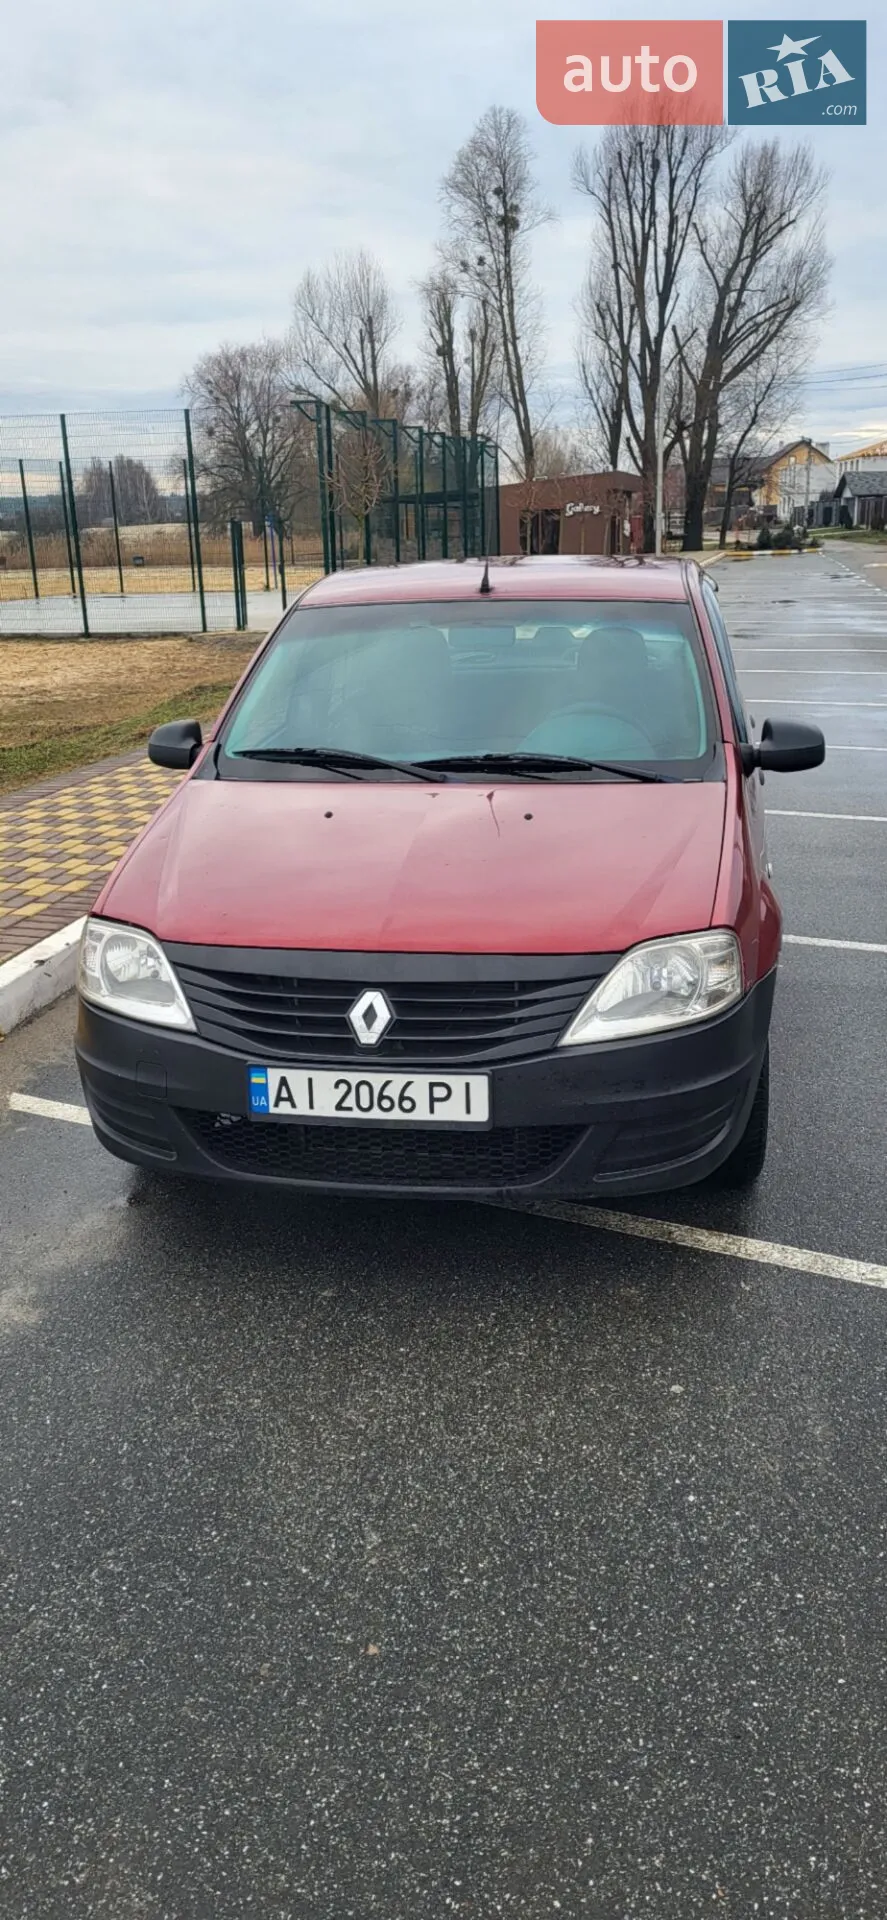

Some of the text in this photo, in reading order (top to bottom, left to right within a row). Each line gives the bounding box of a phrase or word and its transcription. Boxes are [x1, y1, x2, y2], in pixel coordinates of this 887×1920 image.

[252, 1096, 267, 1106] UA
[273, 1075, 471, 1115] AI 2066 PI
